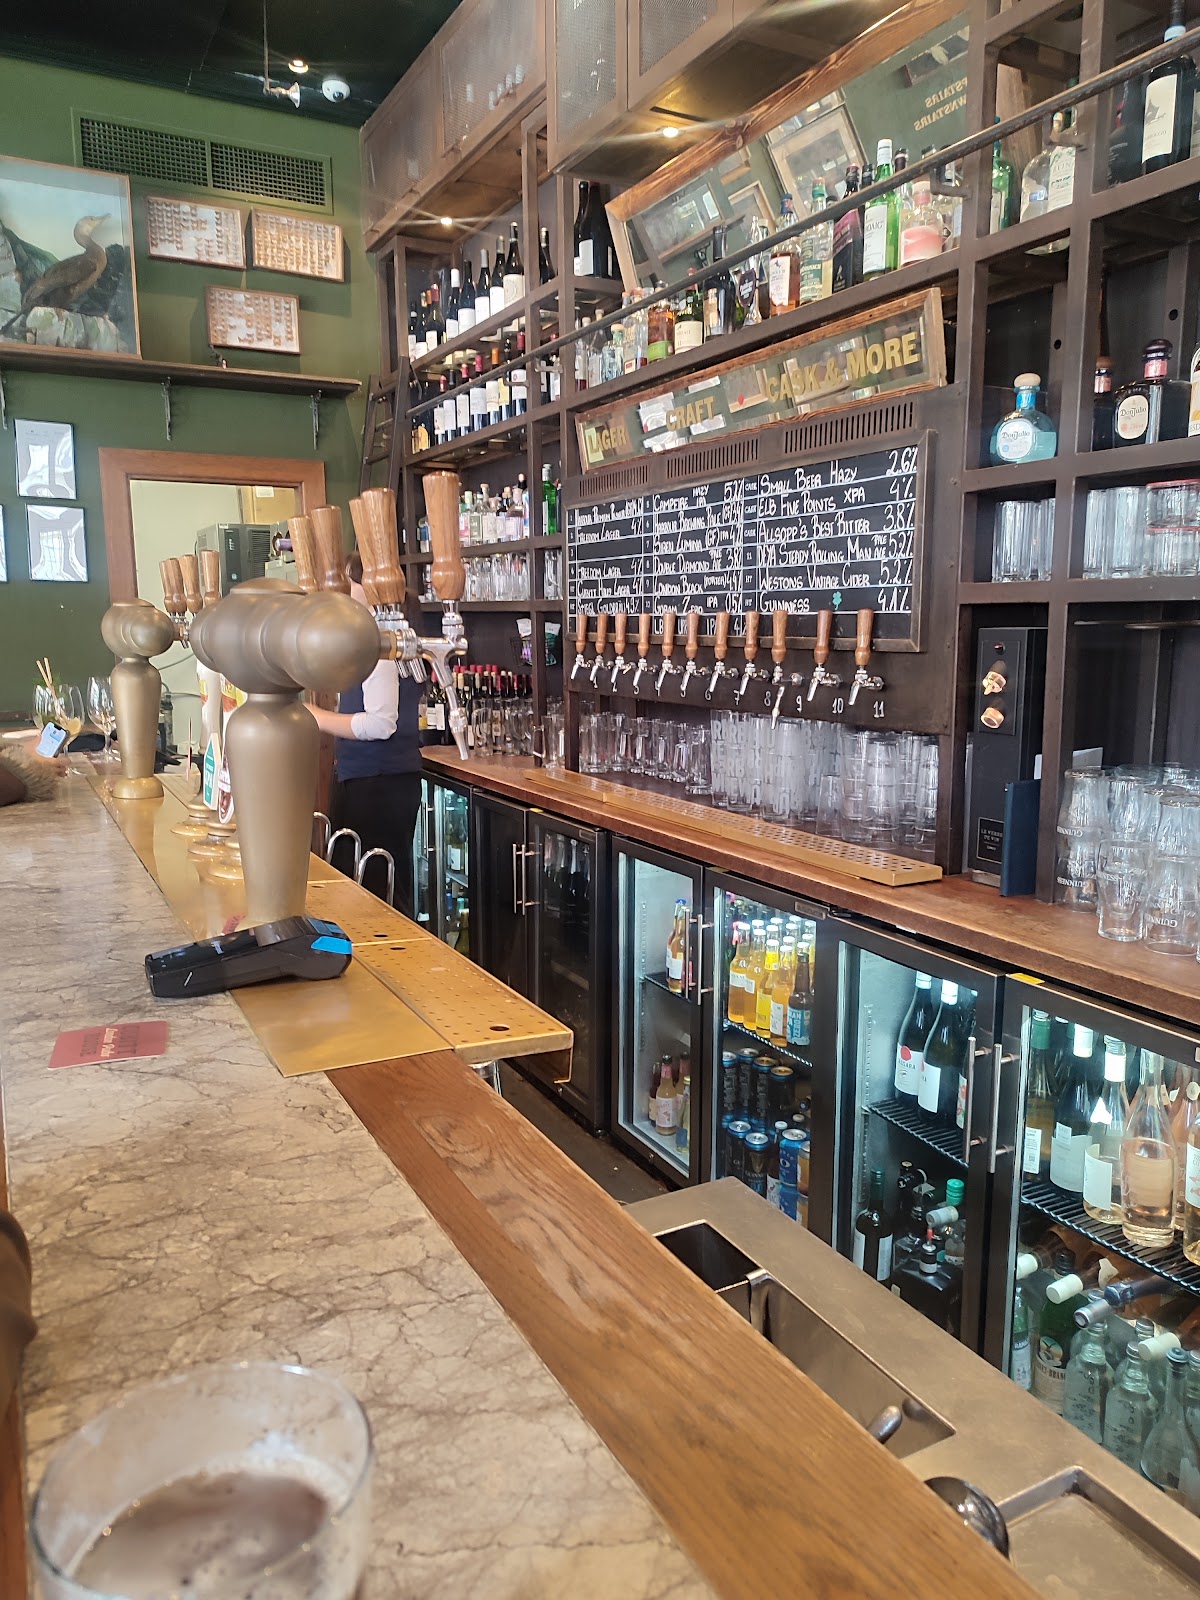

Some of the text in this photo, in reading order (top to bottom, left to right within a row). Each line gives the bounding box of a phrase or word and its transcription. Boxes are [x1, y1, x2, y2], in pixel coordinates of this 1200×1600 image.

[766, 332, 919, 402] CASK & MORE
[665, 396, 715, 432] CRAFT
[587, 424, 628, 451] LAGER
[760, 474, 792, 496] SMALL
[795, 468, 822, 490] BEER
[830, 459, 859, 484] HAZY
[886, 447, 918, 476] 2.6%
[654, 494, 689, 511] CAMPFIRE
[780, 495, 800, 516] FIVE
[801, 490, 836, 514] POINTS
[843, 487, 866, 504] XPA
[889, 476, 914, 502] 4%
[600, 522, 620, 541] LAGER
[758, 519, 808, 543] ALLSOPP'S
[811, 514, 835, 539] BEST
[835, 511, 871, 536] BITTER
[883, 502, 915, 532] 3.8%
[779, 541, 809, 564] STEADY
[808, 539, 845, 563] ROLLING
[847, 536, 872, 560] MAN
[888, 530, 914, 559] 5.2%
[759, 567, 804, 591] WESTONS
[806, 564, 840, 588] VINTAGE
[842, 562, 871, 588] CIDER
[878, 559, 914, 586] 5.2%
[706, 596, 718, 608] IPA
[760, 590, 810, 613] GUINNESS
[877, 587, 911, 612] 4.1%
[705, 688, 711, 700] 6
[733, 690, 740, 706] 7
[764, 691, 771, 707] 8
[796, 695, 802, 712] 9
[832, 698, 844, 714] 10
[873, 700, 885, 718] 11
